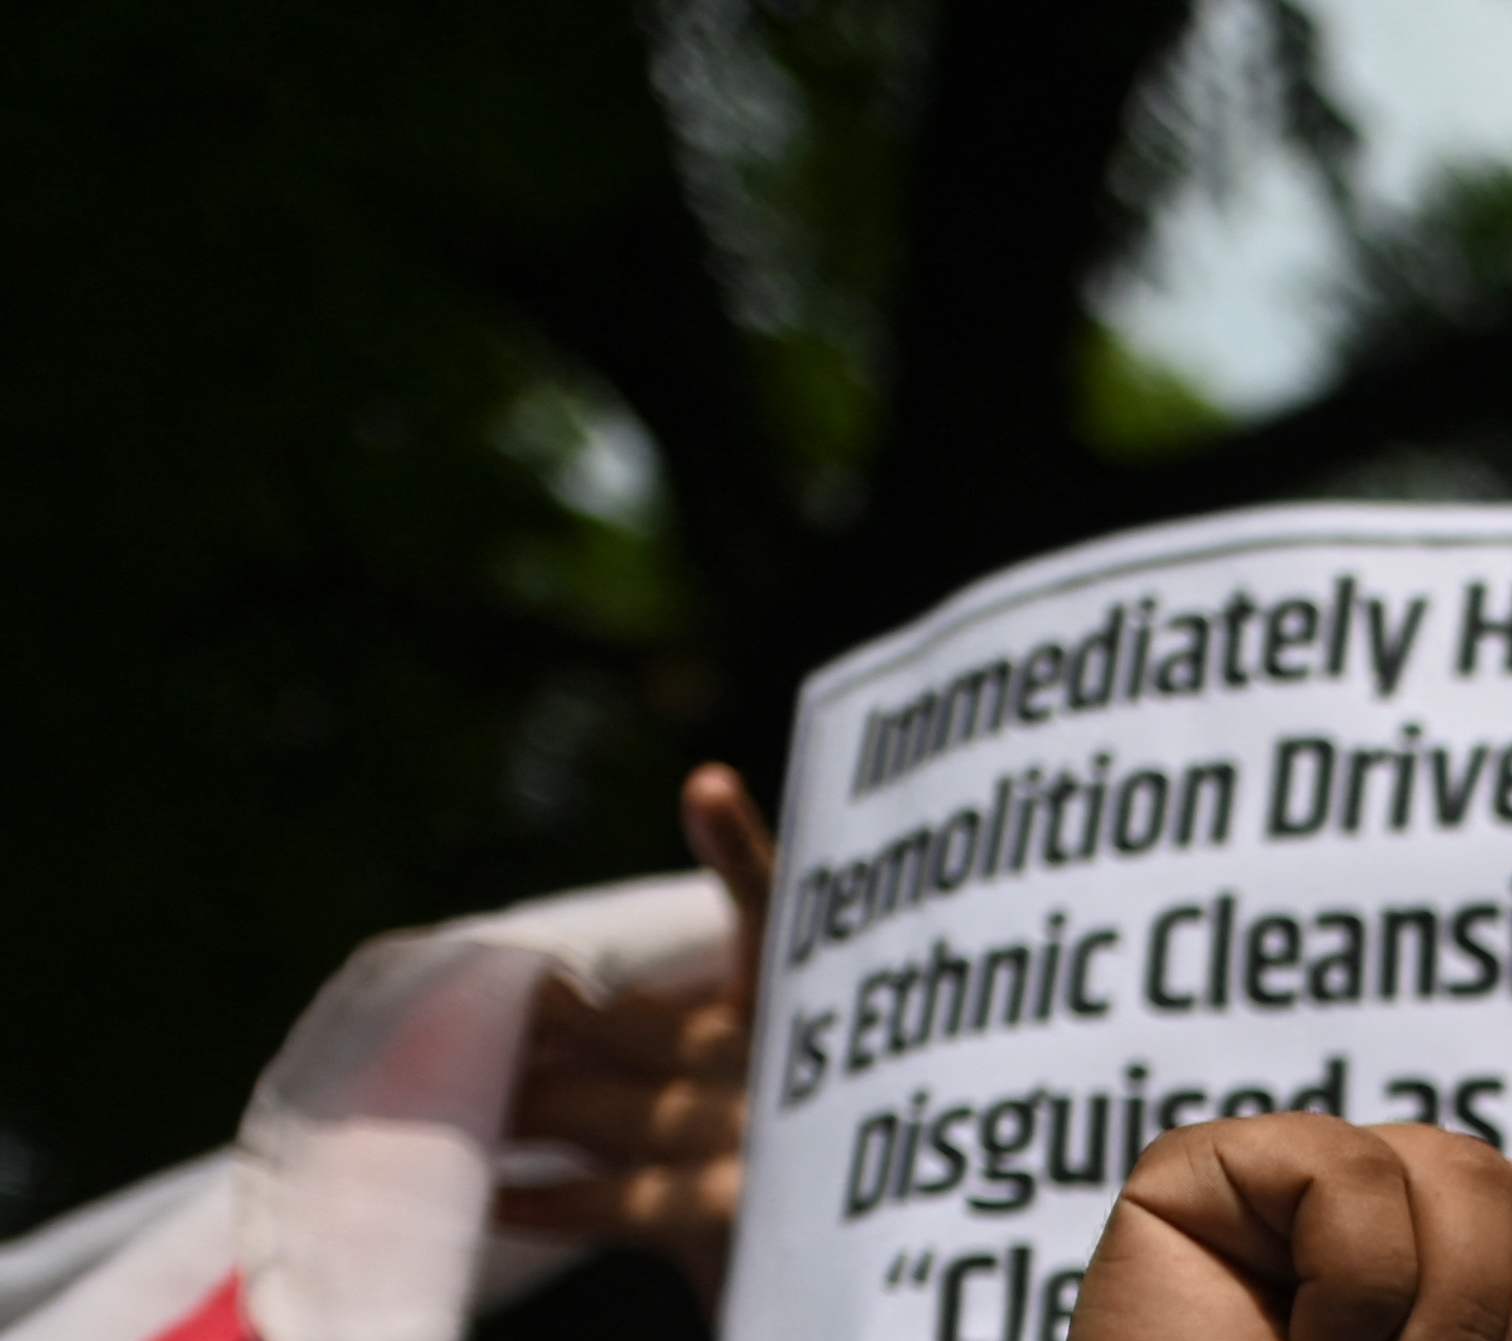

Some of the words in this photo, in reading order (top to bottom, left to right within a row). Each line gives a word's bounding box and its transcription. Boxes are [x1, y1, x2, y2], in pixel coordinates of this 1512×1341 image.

[850, 574, 1426, 797] Immediately
[786, 759, 1238, 968] Demolition
[842, 908, 1120, 1070] Ethnic
